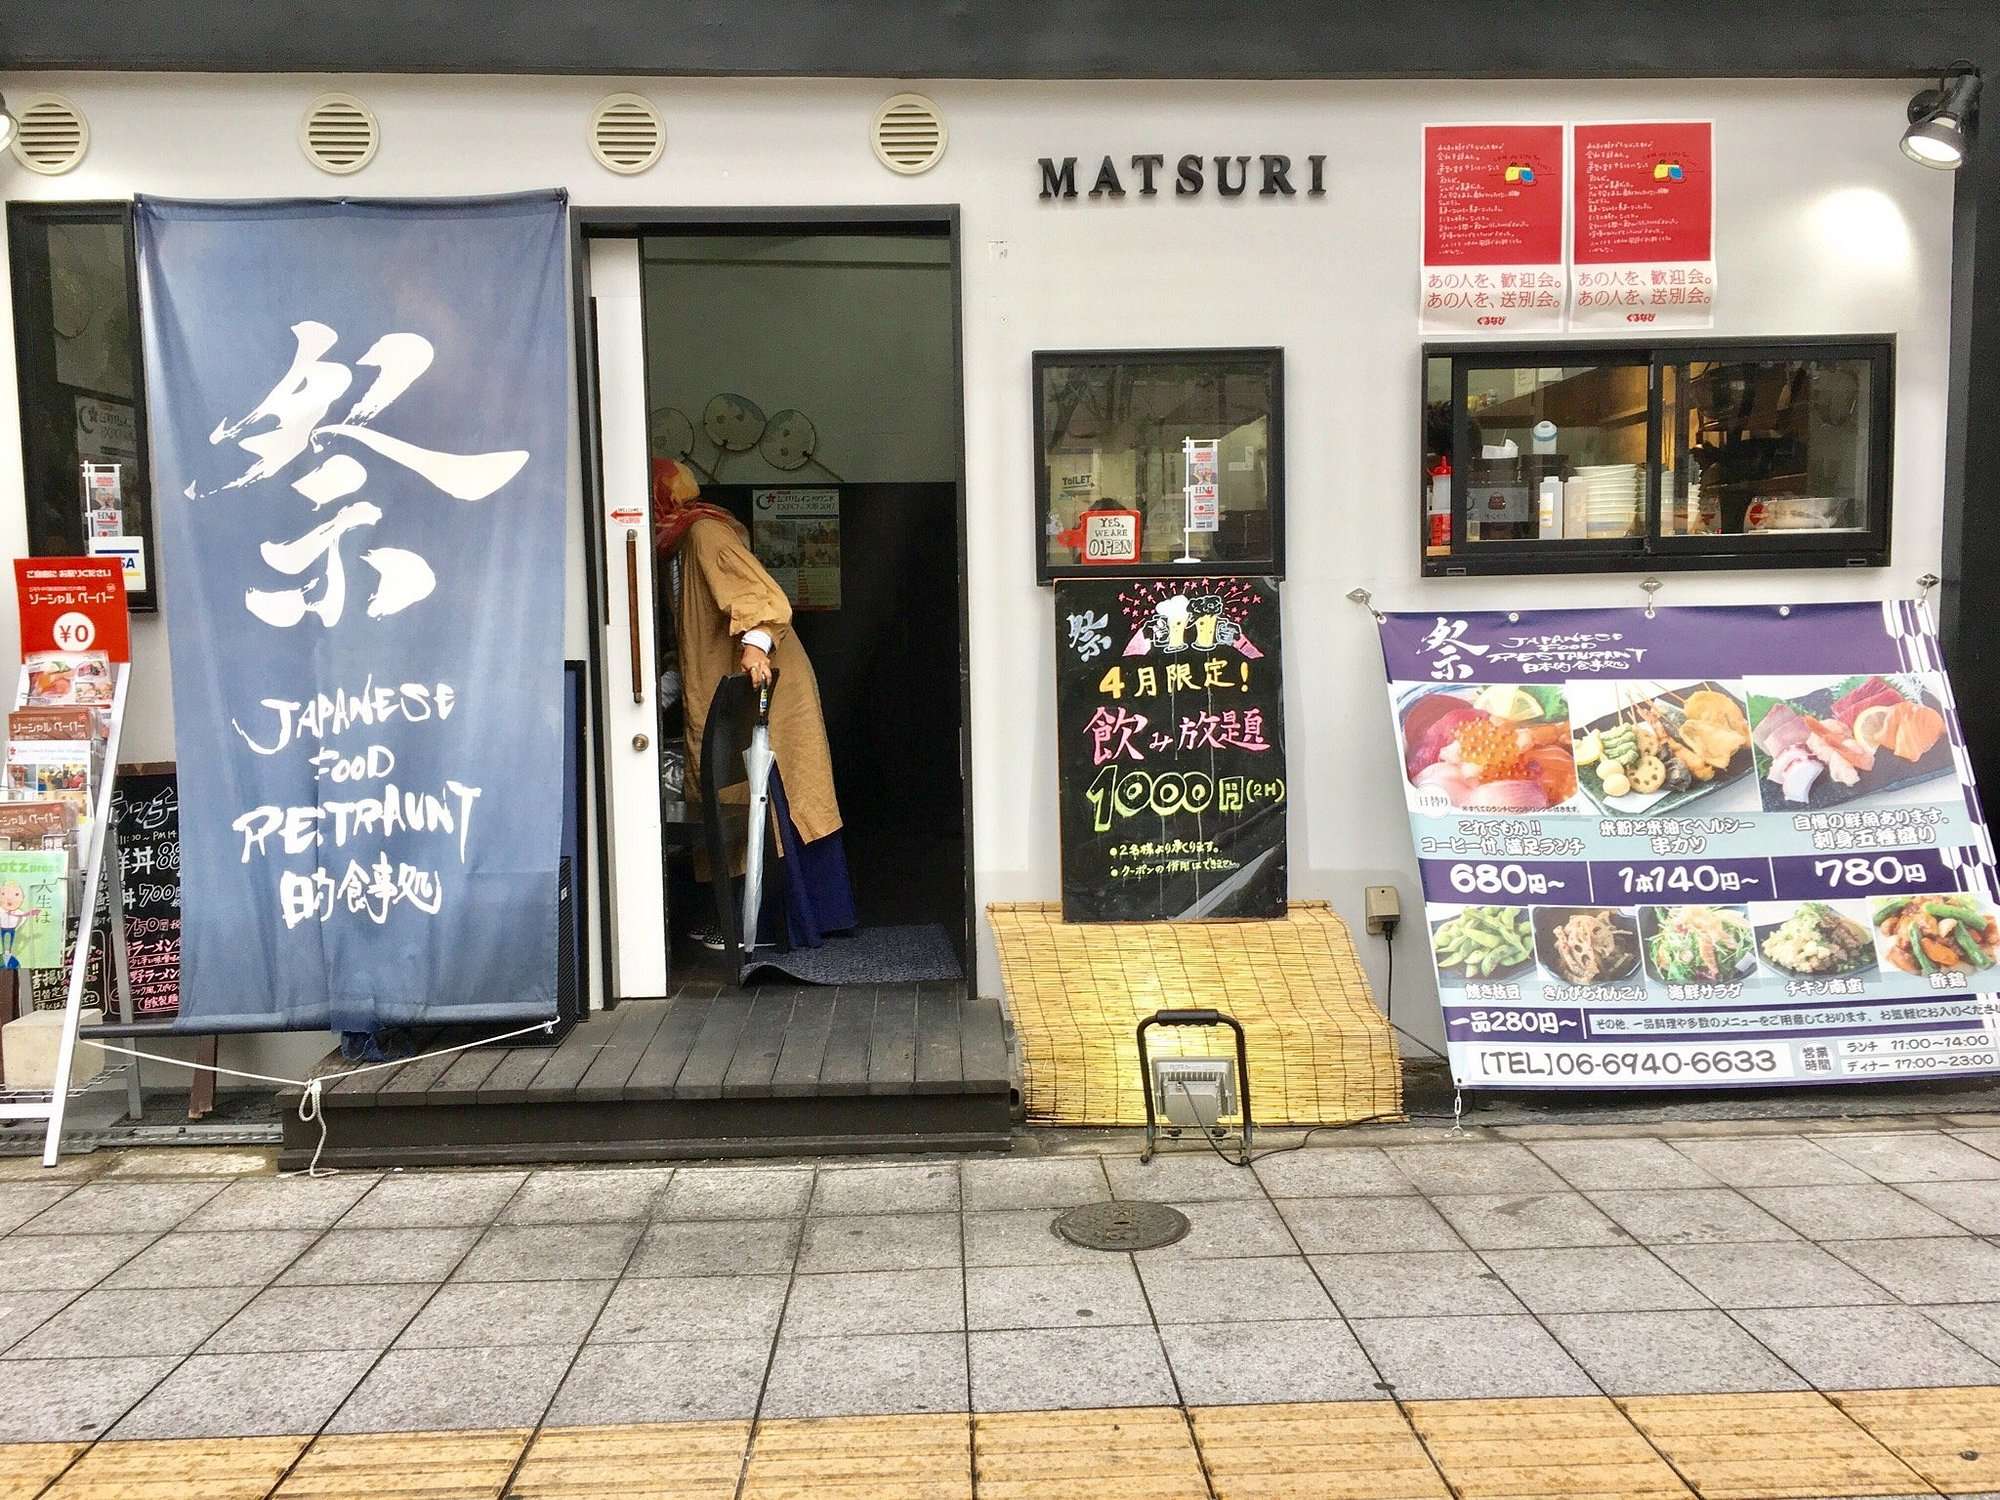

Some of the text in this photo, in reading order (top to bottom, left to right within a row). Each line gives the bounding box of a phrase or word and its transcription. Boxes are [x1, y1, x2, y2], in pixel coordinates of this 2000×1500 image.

[1038, 153, 1328, 199] MATSURI
[1427, 271, 1562, 290] あの人を、歓迎会。
[1577, 268, 1712, 287] あの人を、歓迎会。
[1426, 290, 1561, 309] あの人を、送別会。
[1577, 287, 1712, 306] あの人を、送別会。
[1476, 315, 1507, 326] ぐるなび
[1626, 312, 1656, 323] ぐるなび
[184, 320, 530, 628] 祭
[1100, 517, 1125, 528] YES,
[1088, 539, 1133, 556] OPEN
[1066, 609, 1112, 663] 祭
[1416, 617, 1490, 680] 祭
[232, 674, 456, 755] JAPANESE
[1083, 706, 1271, 765] 飲み放題
[308, 745, 395, 781] FOOD
[231, 781, 482, 864] RETRAUNT
[1600, 818, 1755, 836] 米粉と米油でヘルシー
[1793, 807, 1950, 831] 自慢の鮮魚あります。
[1651, 836, 1707, 855] 串カツ
[1813, 826, 1937, 849] 刺身五種盛り
[1815, 857, 1927, 888] 780円
[1465, 984, 1521, 1000] 焼き枝豆
[1668, 982, 1743, 1000] 海鮮サラダ
[1785, 979, 1865, 995] チキン南蛮
[1847, 1041, 1878, 1053] ランチ
[1847, 1061, 1890, 1072] ディナー
